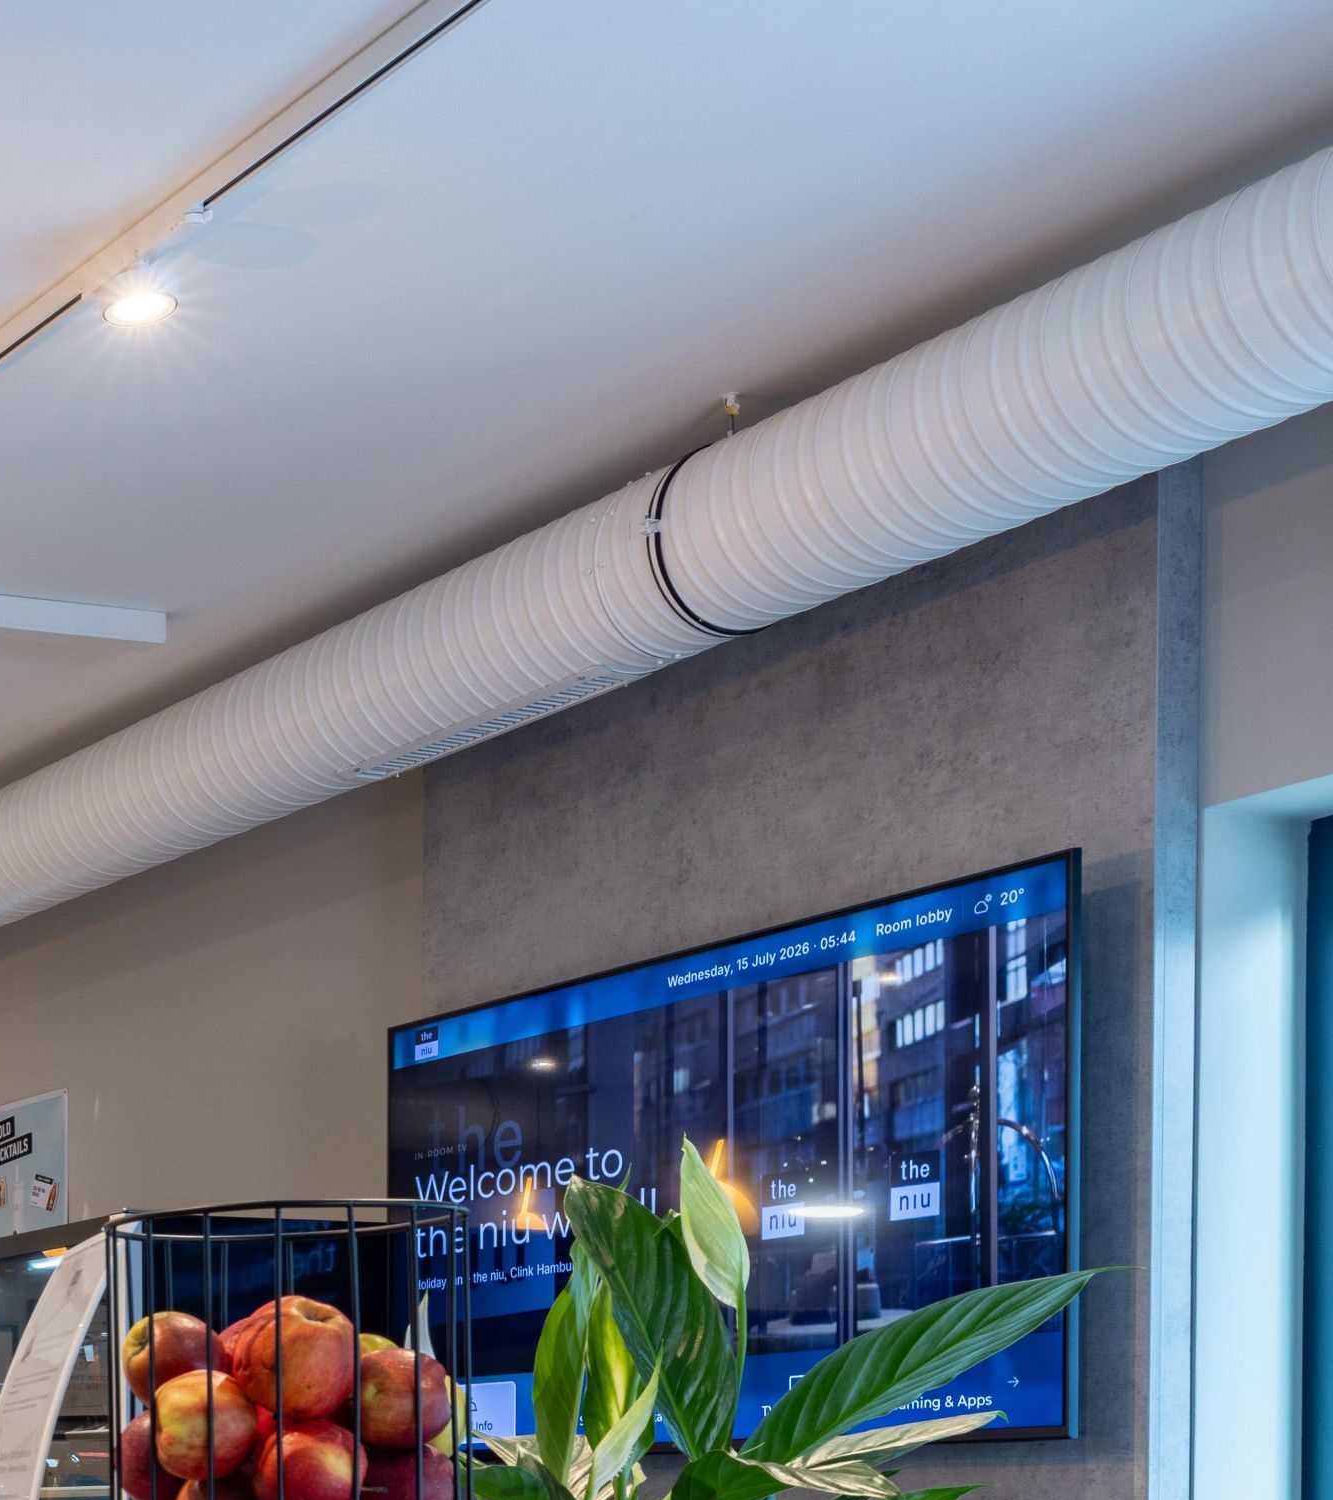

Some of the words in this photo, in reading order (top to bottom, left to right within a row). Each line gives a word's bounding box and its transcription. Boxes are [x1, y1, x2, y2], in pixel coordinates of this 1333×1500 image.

[1000, 888, 1025, 906] 20°
[876, 918, 912, 936] Room
[916, 908, 953, 927] lobby
[667, 963, 734, 989] Wednesday,
[737, 957, 749, 971] 15
[752, 951, 776, 968] July
[780, 942, 810, 960] 2026
[820, 930, 857, 950] 05:44
[421, 1031, 433, 1042] the
[421, 1046, 433, 1057] niu
[415, 1157, 575, 1205] Welcome
[586, 1147, 623, 1181] to
[901, 1159, 931, 1180] the
[770, 1178, 797, 1200] the
[899, 1192, 931, 1211] niu
[769, 1213, 797, 1231] niu
[416, 1226, 465, 1259] the
[479, 1209, 530, 1250] niu
[473, 1271, 488, 1284] the
[490, 1269, 507, 1283] niu,
[510, 1265, 534, 1279] Clink
[945, 1395, 954, 1408] &
[957, 1394, 993, 1410] Apps
[476, 1420, 493, 1431] Info
